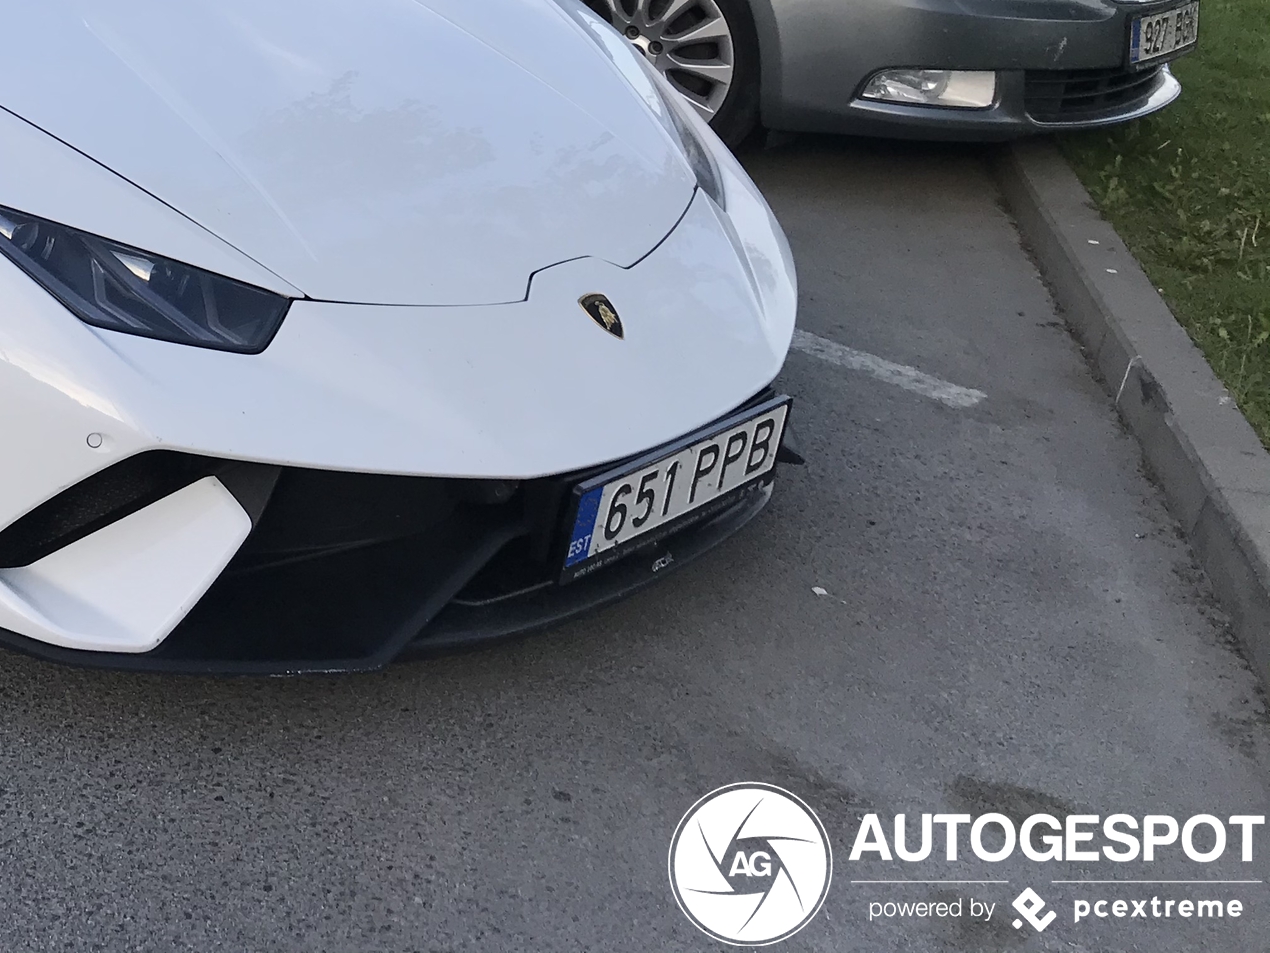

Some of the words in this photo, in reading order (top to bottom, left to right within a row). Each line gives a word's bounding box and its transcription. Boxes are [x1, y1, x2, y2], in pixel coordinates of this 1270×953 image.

[1144, 16, 1169, 54] 927
[603, 460, 679, 541] 651
[687, 417, 776, 504] PPB
[567, 534, 591, 558] EST
